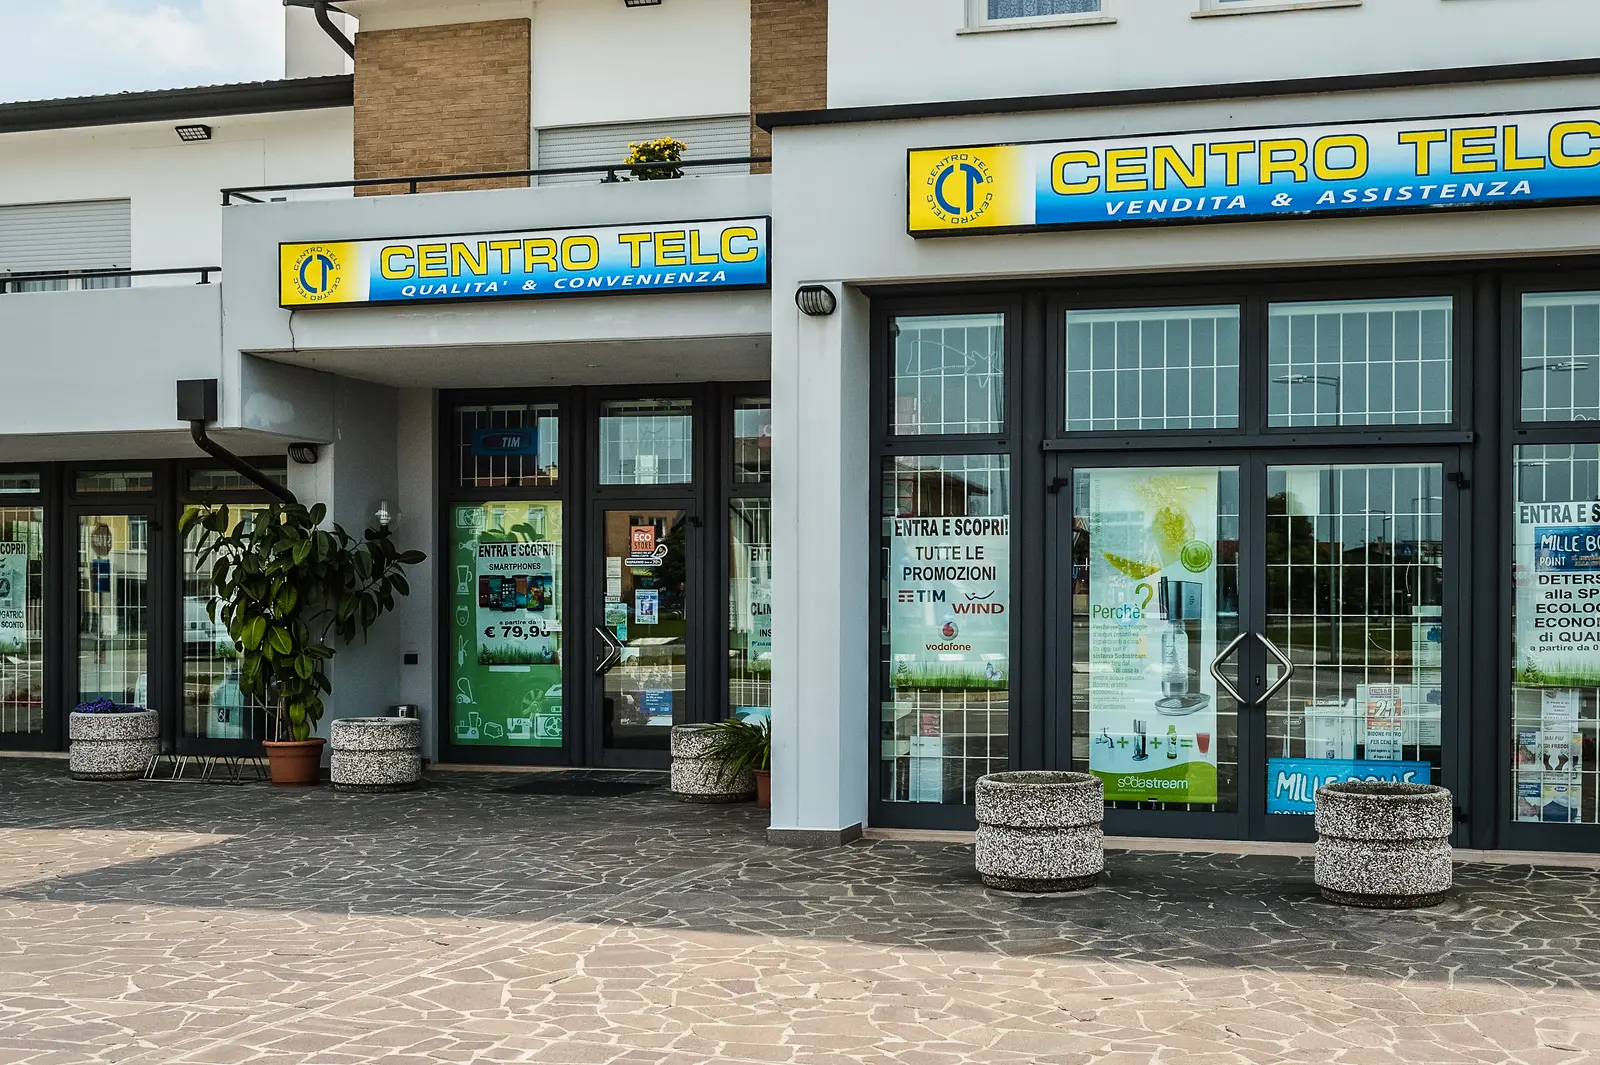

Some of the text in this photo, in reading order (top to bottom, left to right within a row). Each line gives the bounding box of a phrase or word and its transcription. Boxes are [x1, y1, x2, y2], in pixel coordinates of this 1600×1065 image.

[1051, 119, 1600, 196] CENTRO TELC
[926, 153, 994, 186] CENTRO TELC
[1105, 180, 1531, 215] VENDITA & ASSISTENZA
[293, 247, 341, 271] CENTRO TELC
[380, 226, 759, 280] CENTRO TELC
[401, 270, 727, 297] QUALITA' & CONVENIENZA
[502, 437, 520, 448] TIM
[1520, 504, 1573, 524] ENTRA
[1577, 504, 1587, 523] E
[894, 518, 1009, 537] ENTRA E SCOPRI!
[634, 533, 651, 542] ECO
[1540, 534, 1580, 552] MILLE
[478, 544, 509, 558] ENTRA
[510, 544, 517, 557] E
[634, 541, 652, 550] STORE
[915, 545, 984, 560] TUTTE LE
[488, 562, 541, 571] SMARTPHONES
[1540, 556, 1566, 567] POINT
[903, 566, 996, 581] PROMOZIONI
[1545, 588, 1572, 599] alla
[951, 603, 1005, 615] WIND
[0, 621, 24, 629] SCONTO
[484, 626, 496, 638] €
[1539, 632, 1553, 642] di
[926, 642, 971, 651] vodafone
[1539, 644, 1573, 653] partire
[1117, 775, 1189, 789] sodastream
